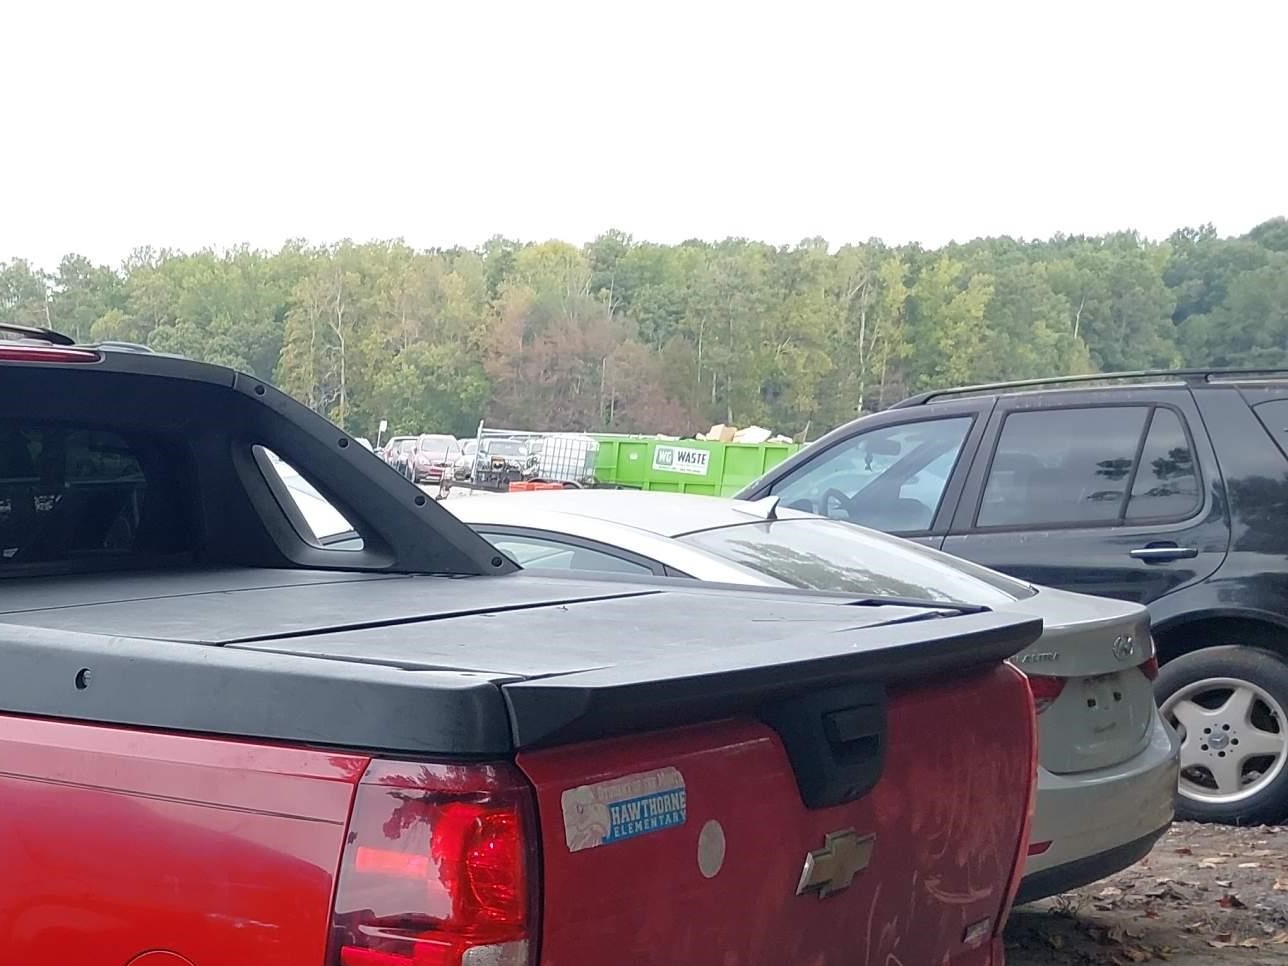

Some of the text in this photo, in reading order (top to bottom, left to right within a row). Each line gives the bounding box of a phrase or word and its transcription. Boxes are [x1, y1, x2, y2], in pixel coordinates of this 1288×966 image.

[677, 450, 707, 465] WASTE
[611, 791, 687, 825] HAWTHORNE
[613, 809, 686, 838] ELEMENTARY
